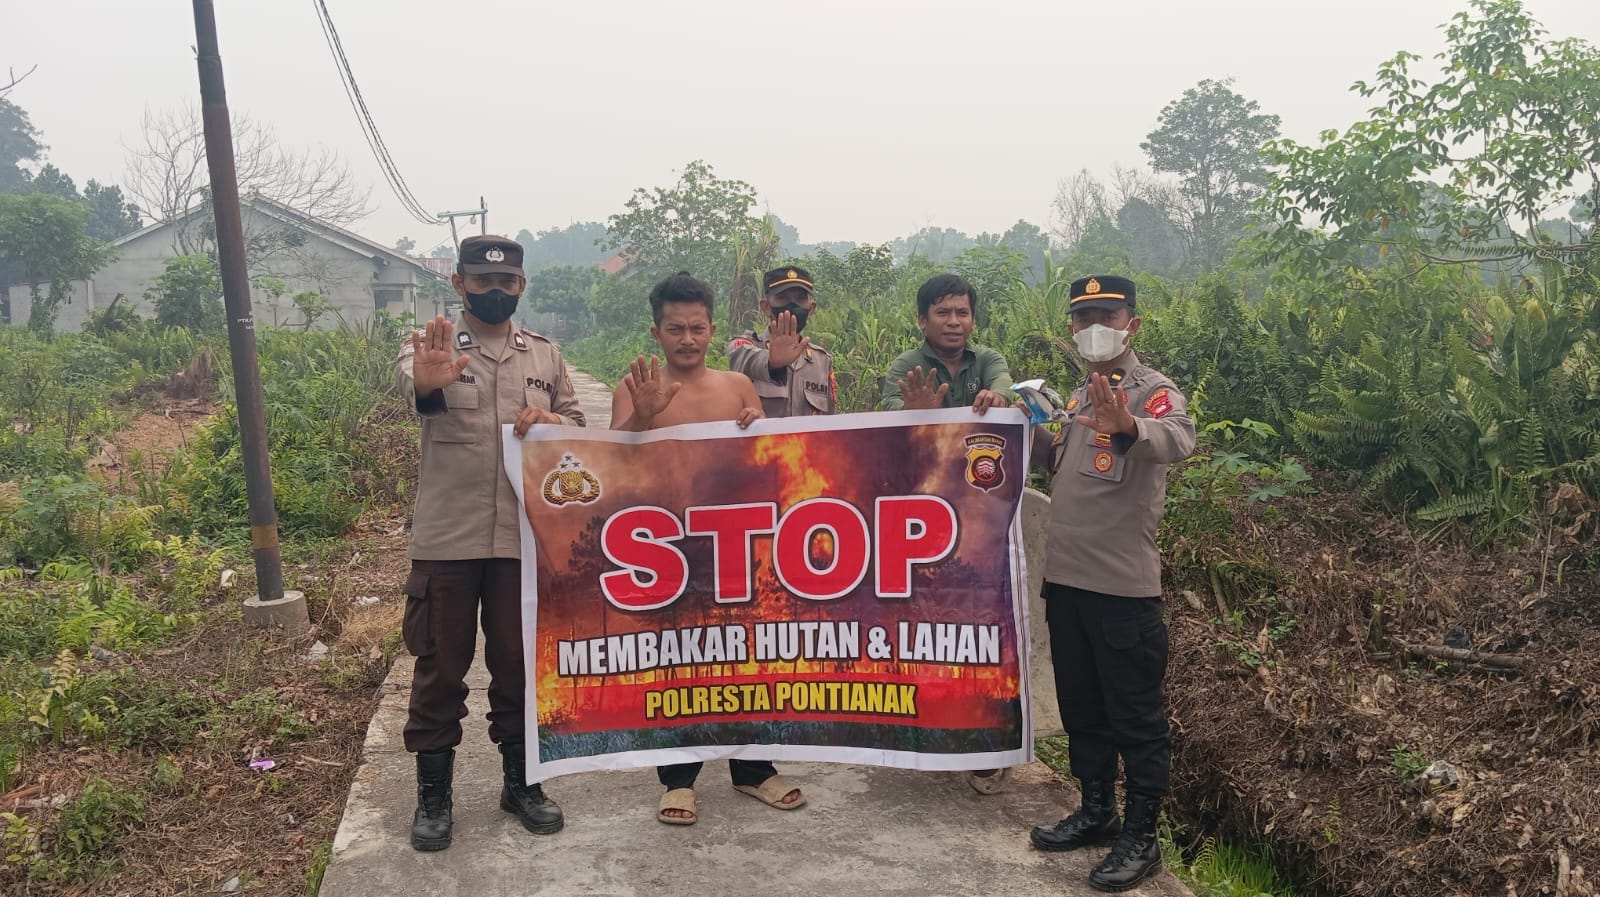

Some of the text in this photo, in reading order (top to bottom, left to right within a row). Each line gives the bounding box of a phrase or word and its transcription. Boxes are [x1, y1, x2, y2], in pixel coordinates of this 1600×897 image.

[600, 494, 958, 611] STOP
[558, 621, 1000, 676] MEMBAKAR HUTAN & LAHAN
[646, 682, 917, 719] POLRESTA PONTIANAK
